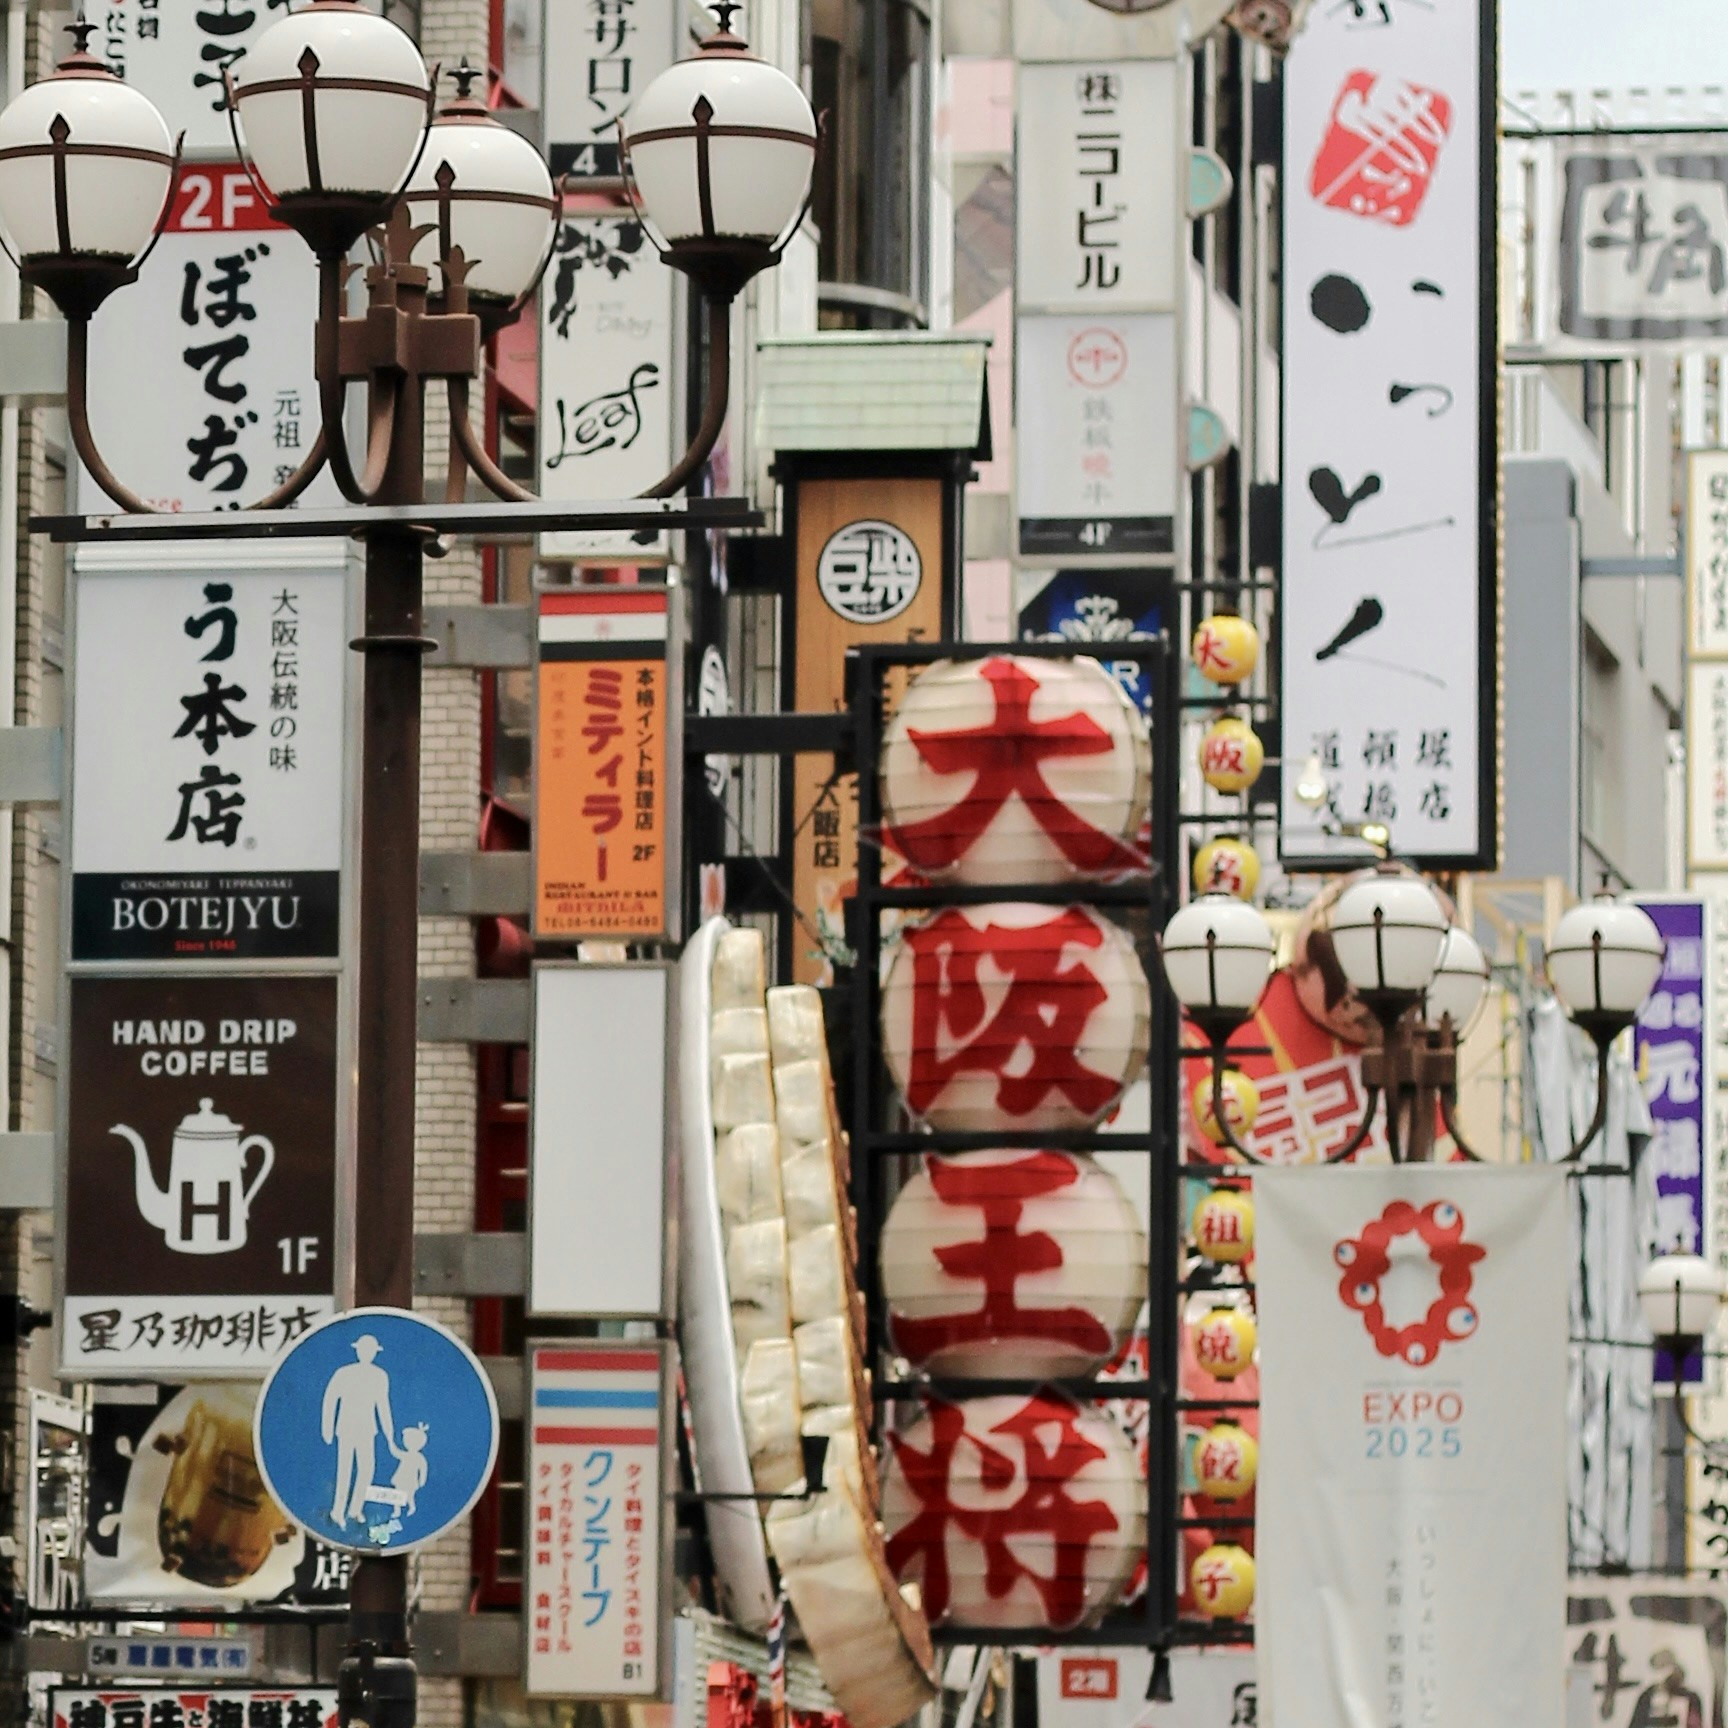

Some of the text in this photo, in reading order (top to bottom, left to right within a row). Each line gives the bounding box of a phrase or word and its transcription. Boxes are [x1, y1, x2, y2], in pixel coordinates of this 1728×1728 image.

[180, 174, 255, 228] 2F
[1588, 188, 1726, 298] 牛角
[547, 363, 659, 469] Leaf
[1078, 522, 1112, 546] 4F
[269, 588, 299, 772] 大阪伝統の味
[581, 668, 624, 882] ミティラー
[633, 845, 656, 862] 2F
[112, 896, 300, 940] BOTEJYU
[112, 1019, 297, 1046] HAND DRIP
[141, 1050, 269, 1076] COFFEE
[278, 1237, 319, 1275] 1F
[1363, 1392, 1463, 1424] EXPO
[1366, 1429, 1462, 1458] 2025
